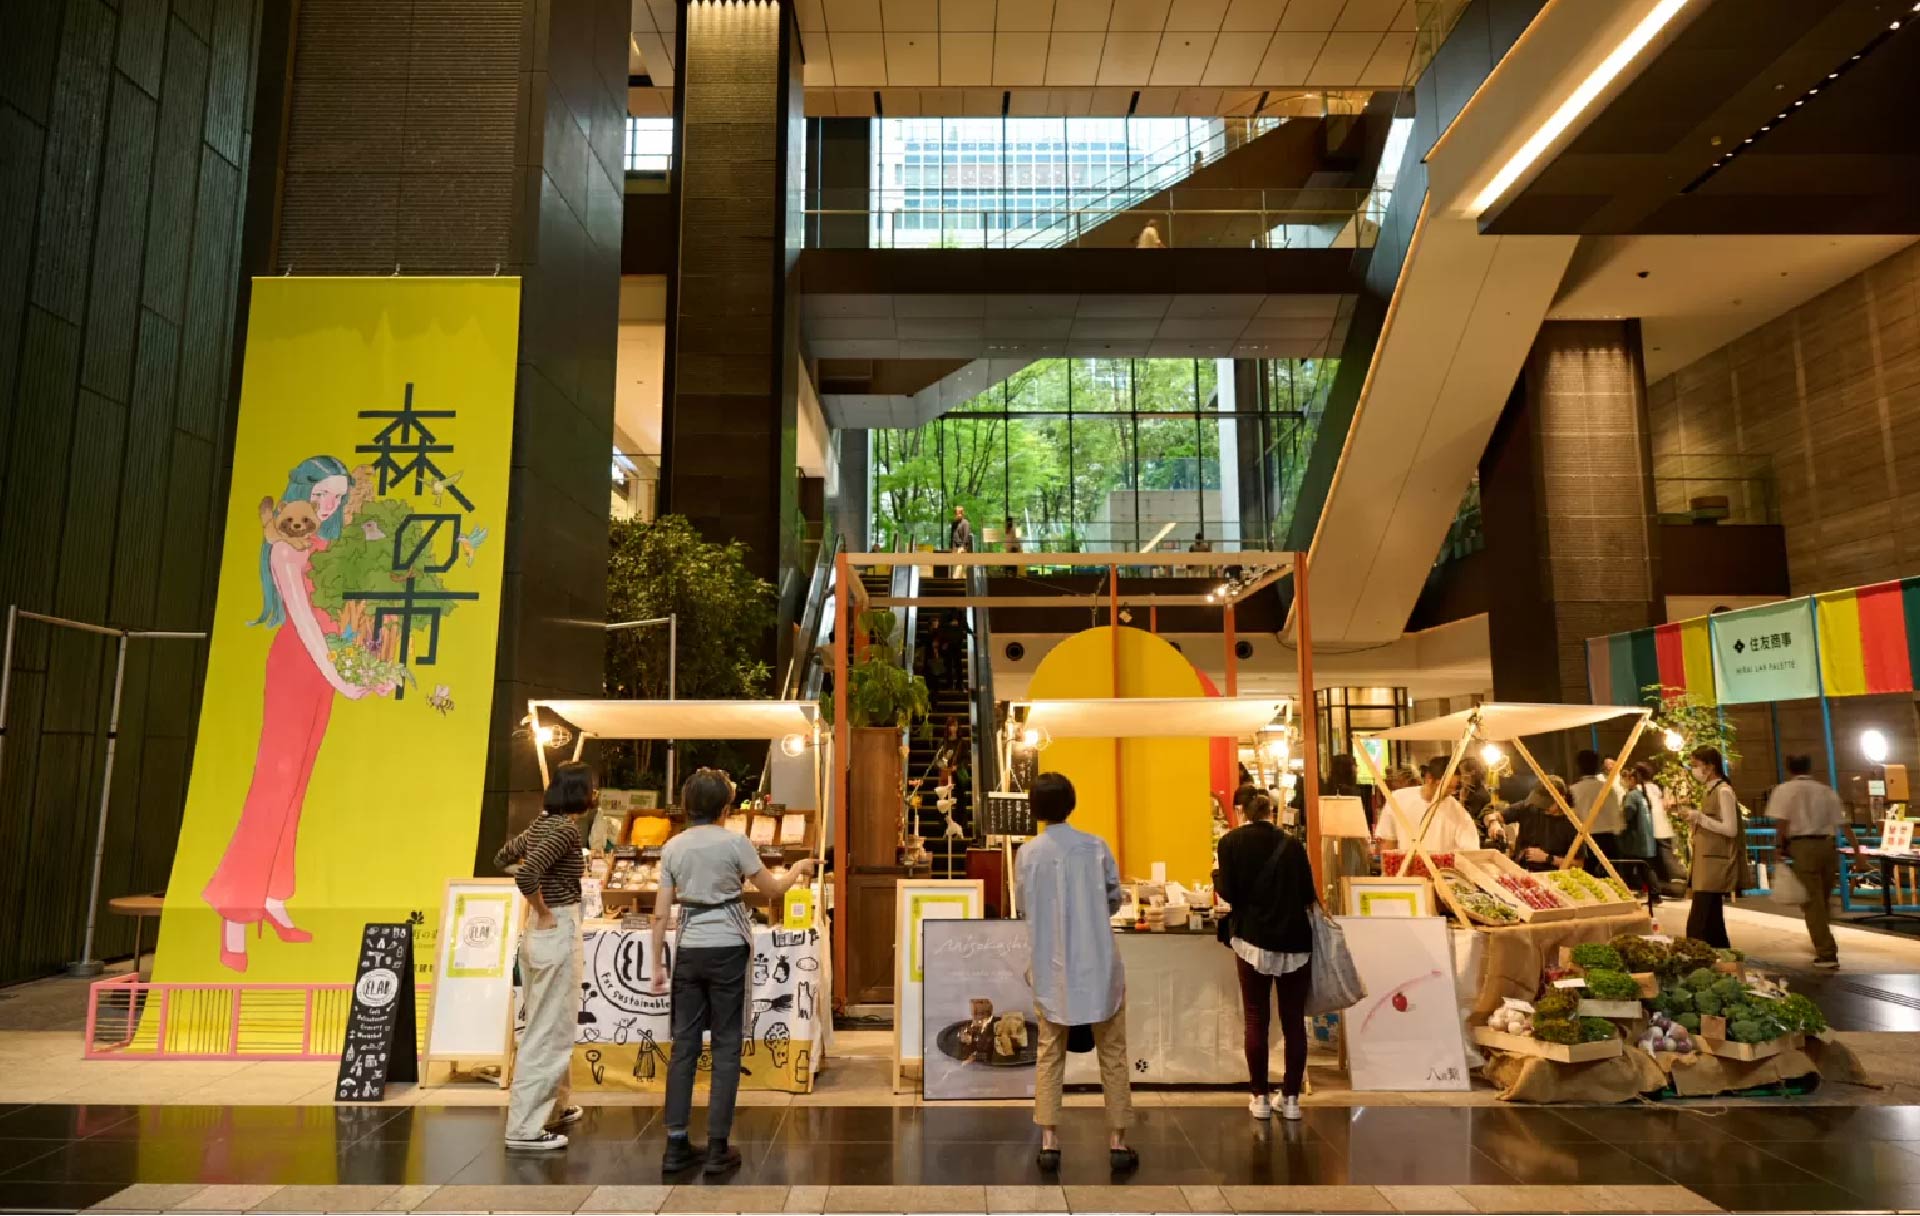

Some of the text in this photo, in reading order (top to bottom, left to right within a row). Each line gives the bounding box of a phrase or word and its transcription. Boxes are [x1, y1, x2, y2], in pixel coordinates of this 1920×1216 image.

[342, 382, 480, 700] 森の市
[1750, 631, 1792, 651] 住友商事
[622, 940, 672, 981] ELA
